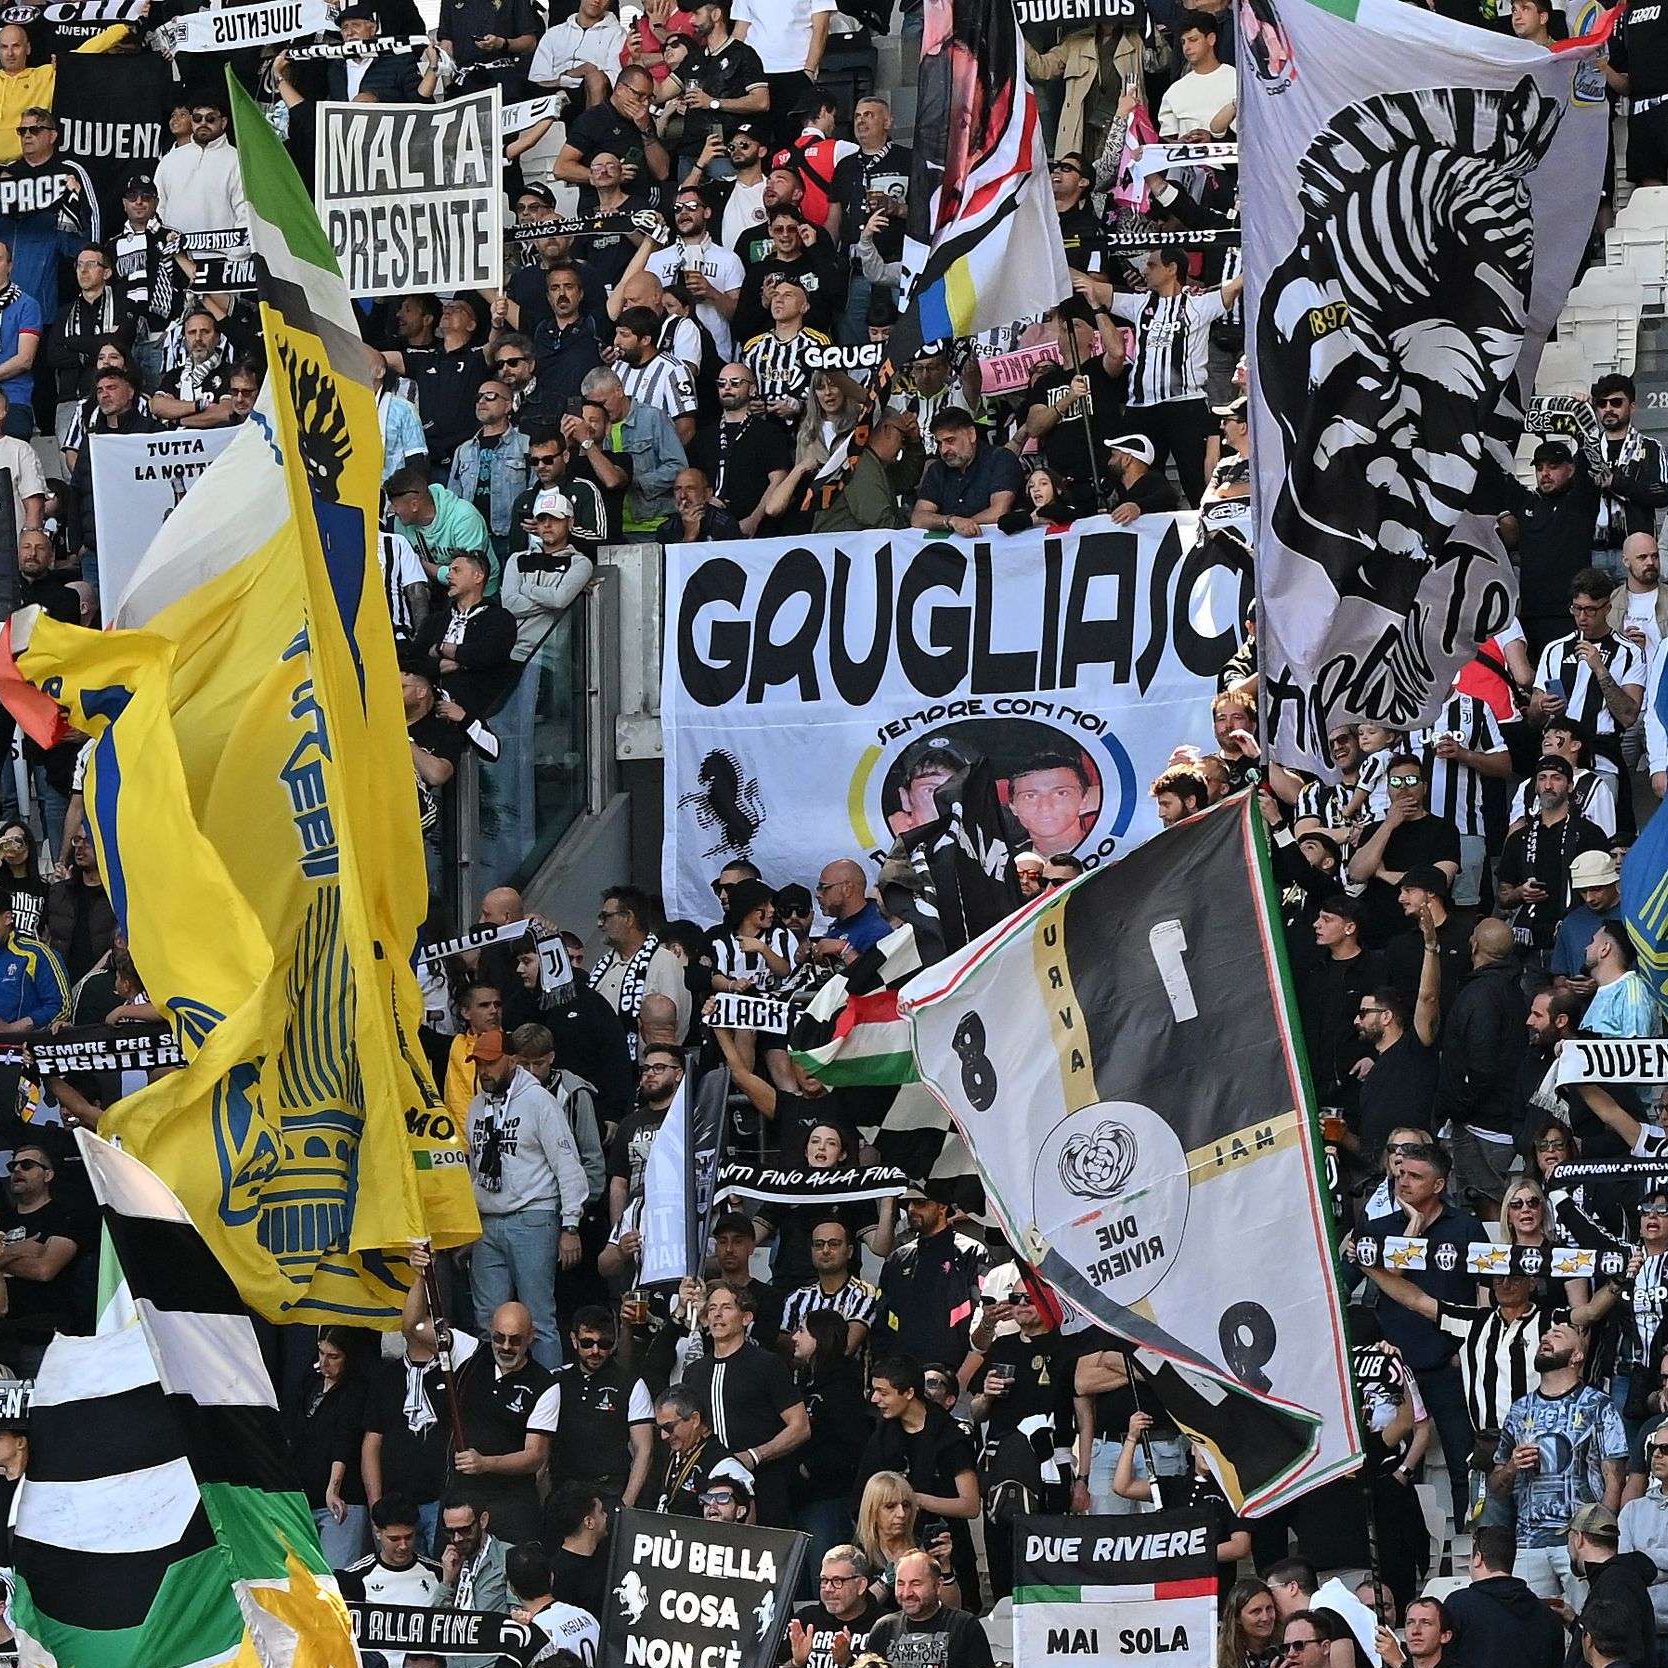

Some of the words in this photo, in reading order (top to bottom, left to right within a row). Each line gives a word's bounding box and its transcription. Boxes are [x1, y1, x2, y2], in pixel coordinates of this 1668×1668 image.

[334, 106, 489, 190] MALTA
[185, 230, 241, 249] JUVENTUS
[332, 198, 490, 290] PRESENTE
[516, 225, 555, 240] SIAMO
[1142, 319, 1183, 334] Jeep
[1310, 302, 1348, 337] 1897
[1646, 391, 1668, 409] 28
[149, 440, 205, 458] TUTTA
[135, 466, 156, 481] LA
[878, 700, 986, 745] SEMPRE
[994, 698, 1052, 718] CON
[1060, 708, 1110, 737] NOI
[633, 1534, 682, 1566] PIÙ
[689, 1544, 777, 1583] BELLA
[1025, 1535, 1079, 1562] DUE
[1093, 1528, 1208, 1563] RIVIERE
[369, 1610, 423, 1640] ALLA
[432, 1613, 481, 1643] FINE
[660, 1591, 740, 1630] COSA
[625, 1636, 690, 1668] NON
[1047, 1628, 1099, 1655] MAI
[1120, 1625, 1189, 1655] SOLA
